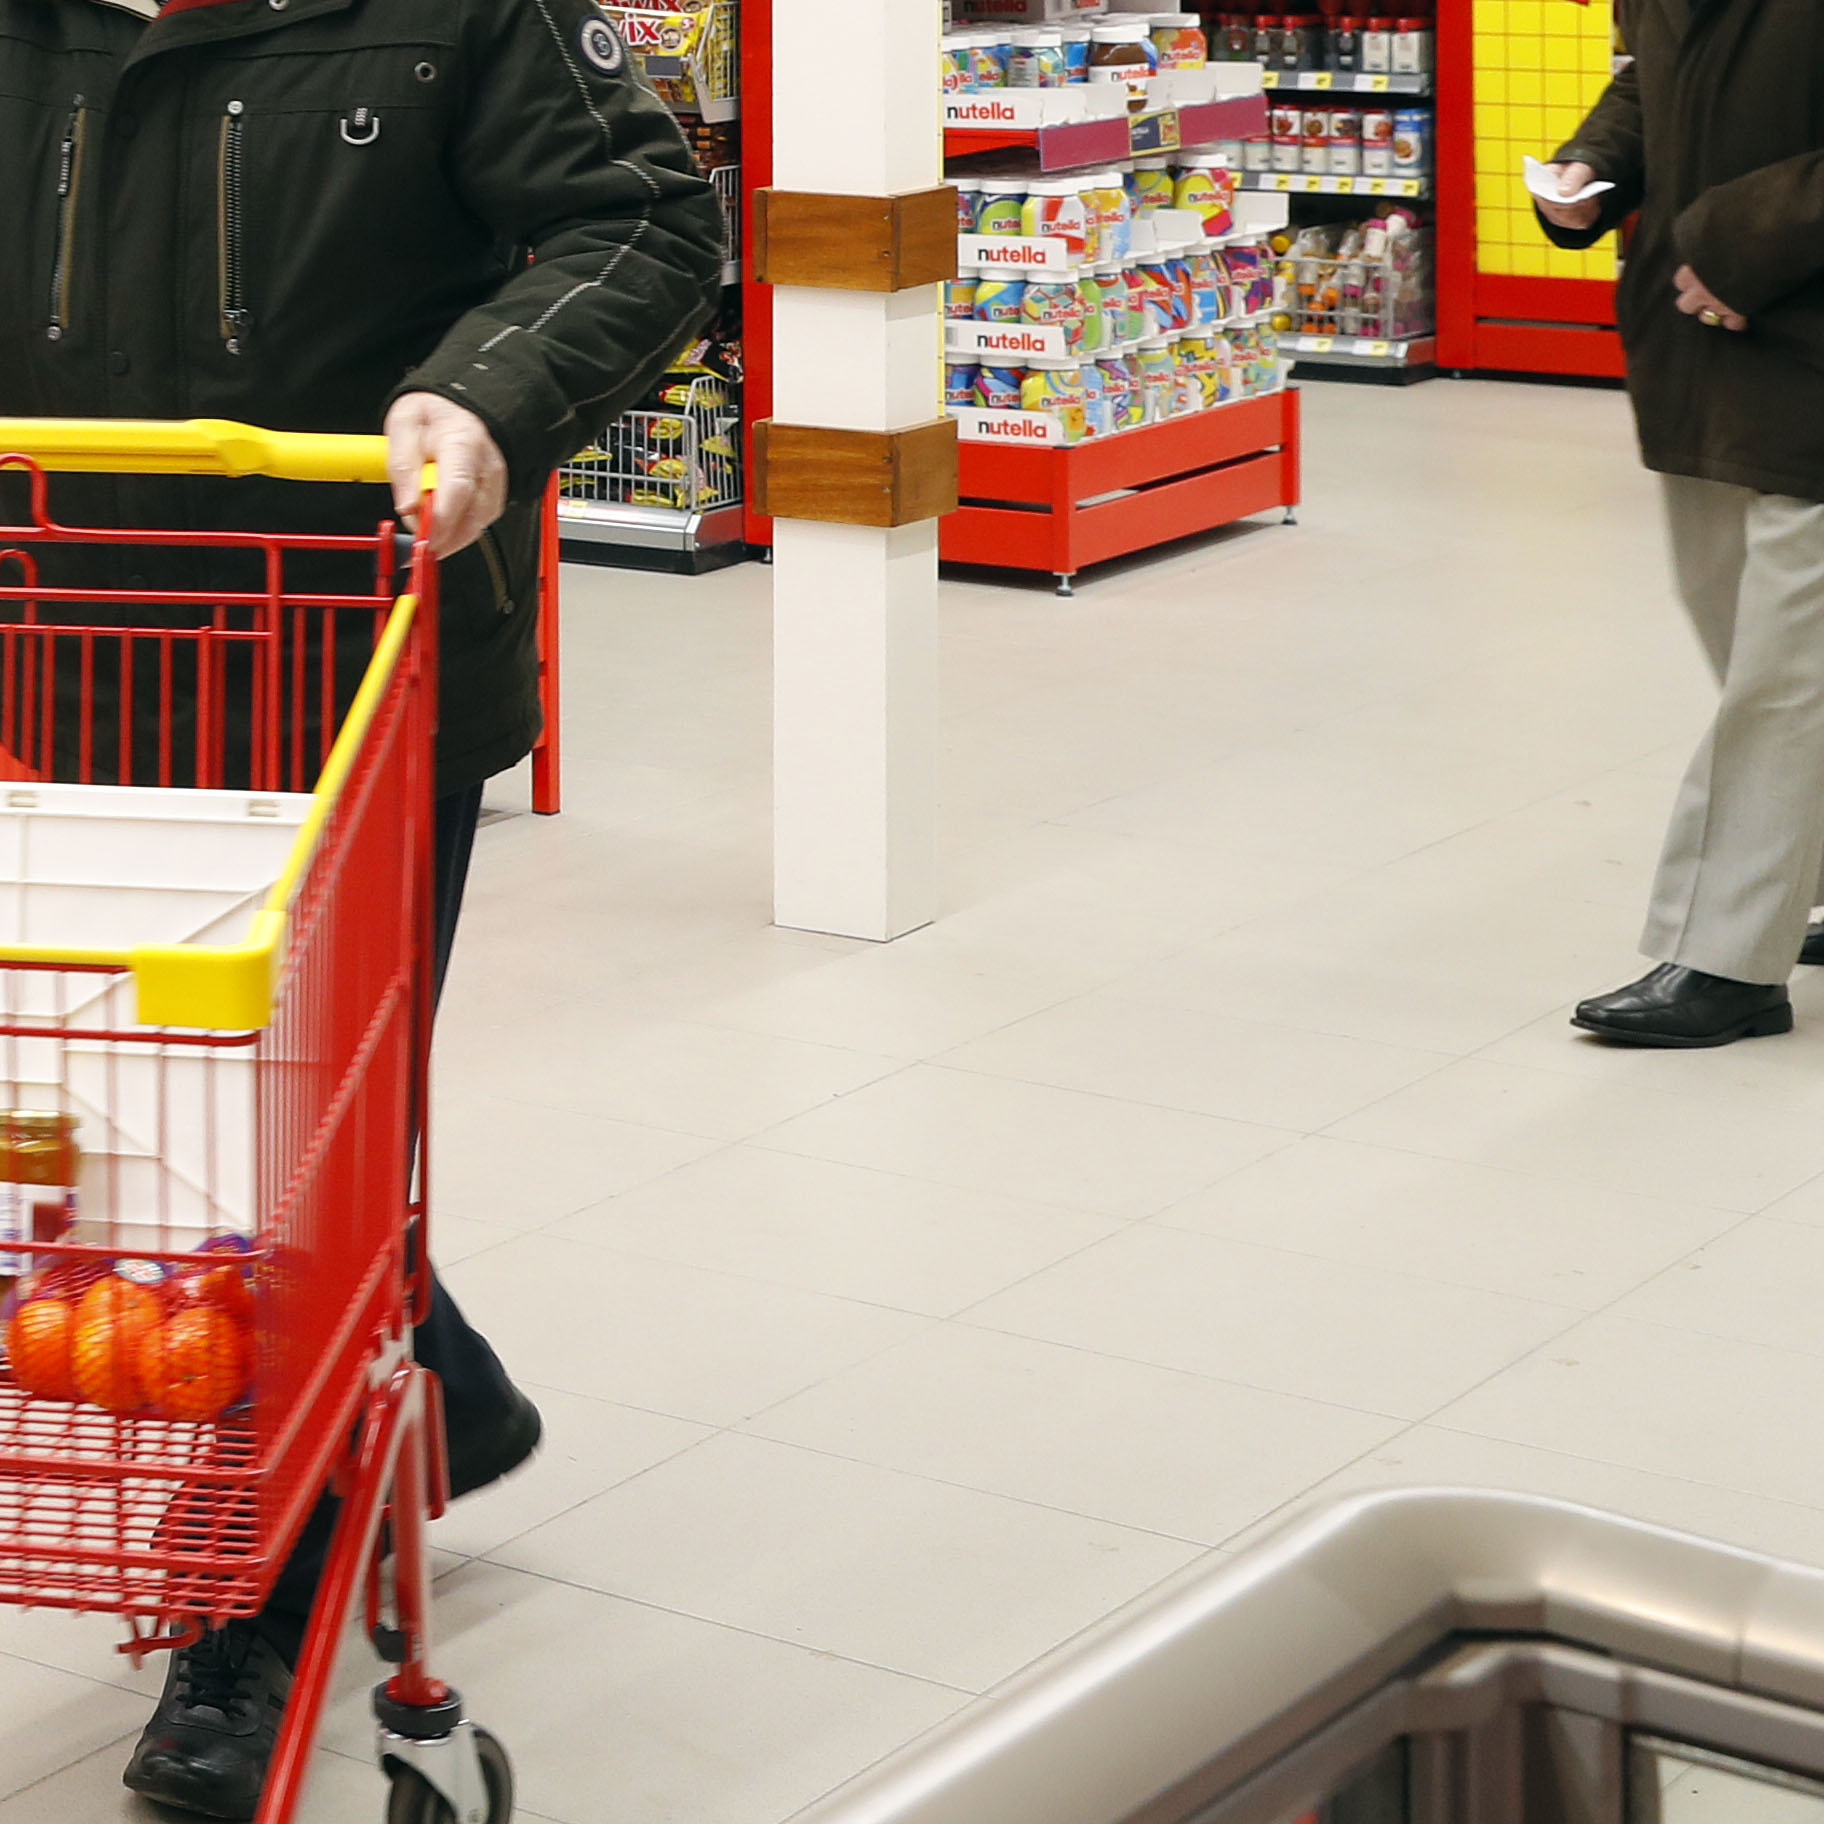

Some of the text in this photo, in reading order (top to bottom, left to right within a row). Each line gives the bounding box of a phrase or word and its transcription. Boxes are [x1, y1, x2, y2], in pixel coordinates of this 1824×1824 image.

[947, 101, 1015, 122] nutella
[977, 244, 1047, 265] nutella
[976, 332, 1046, 353] nutella
[977, 418, 1047, 439] nutella
